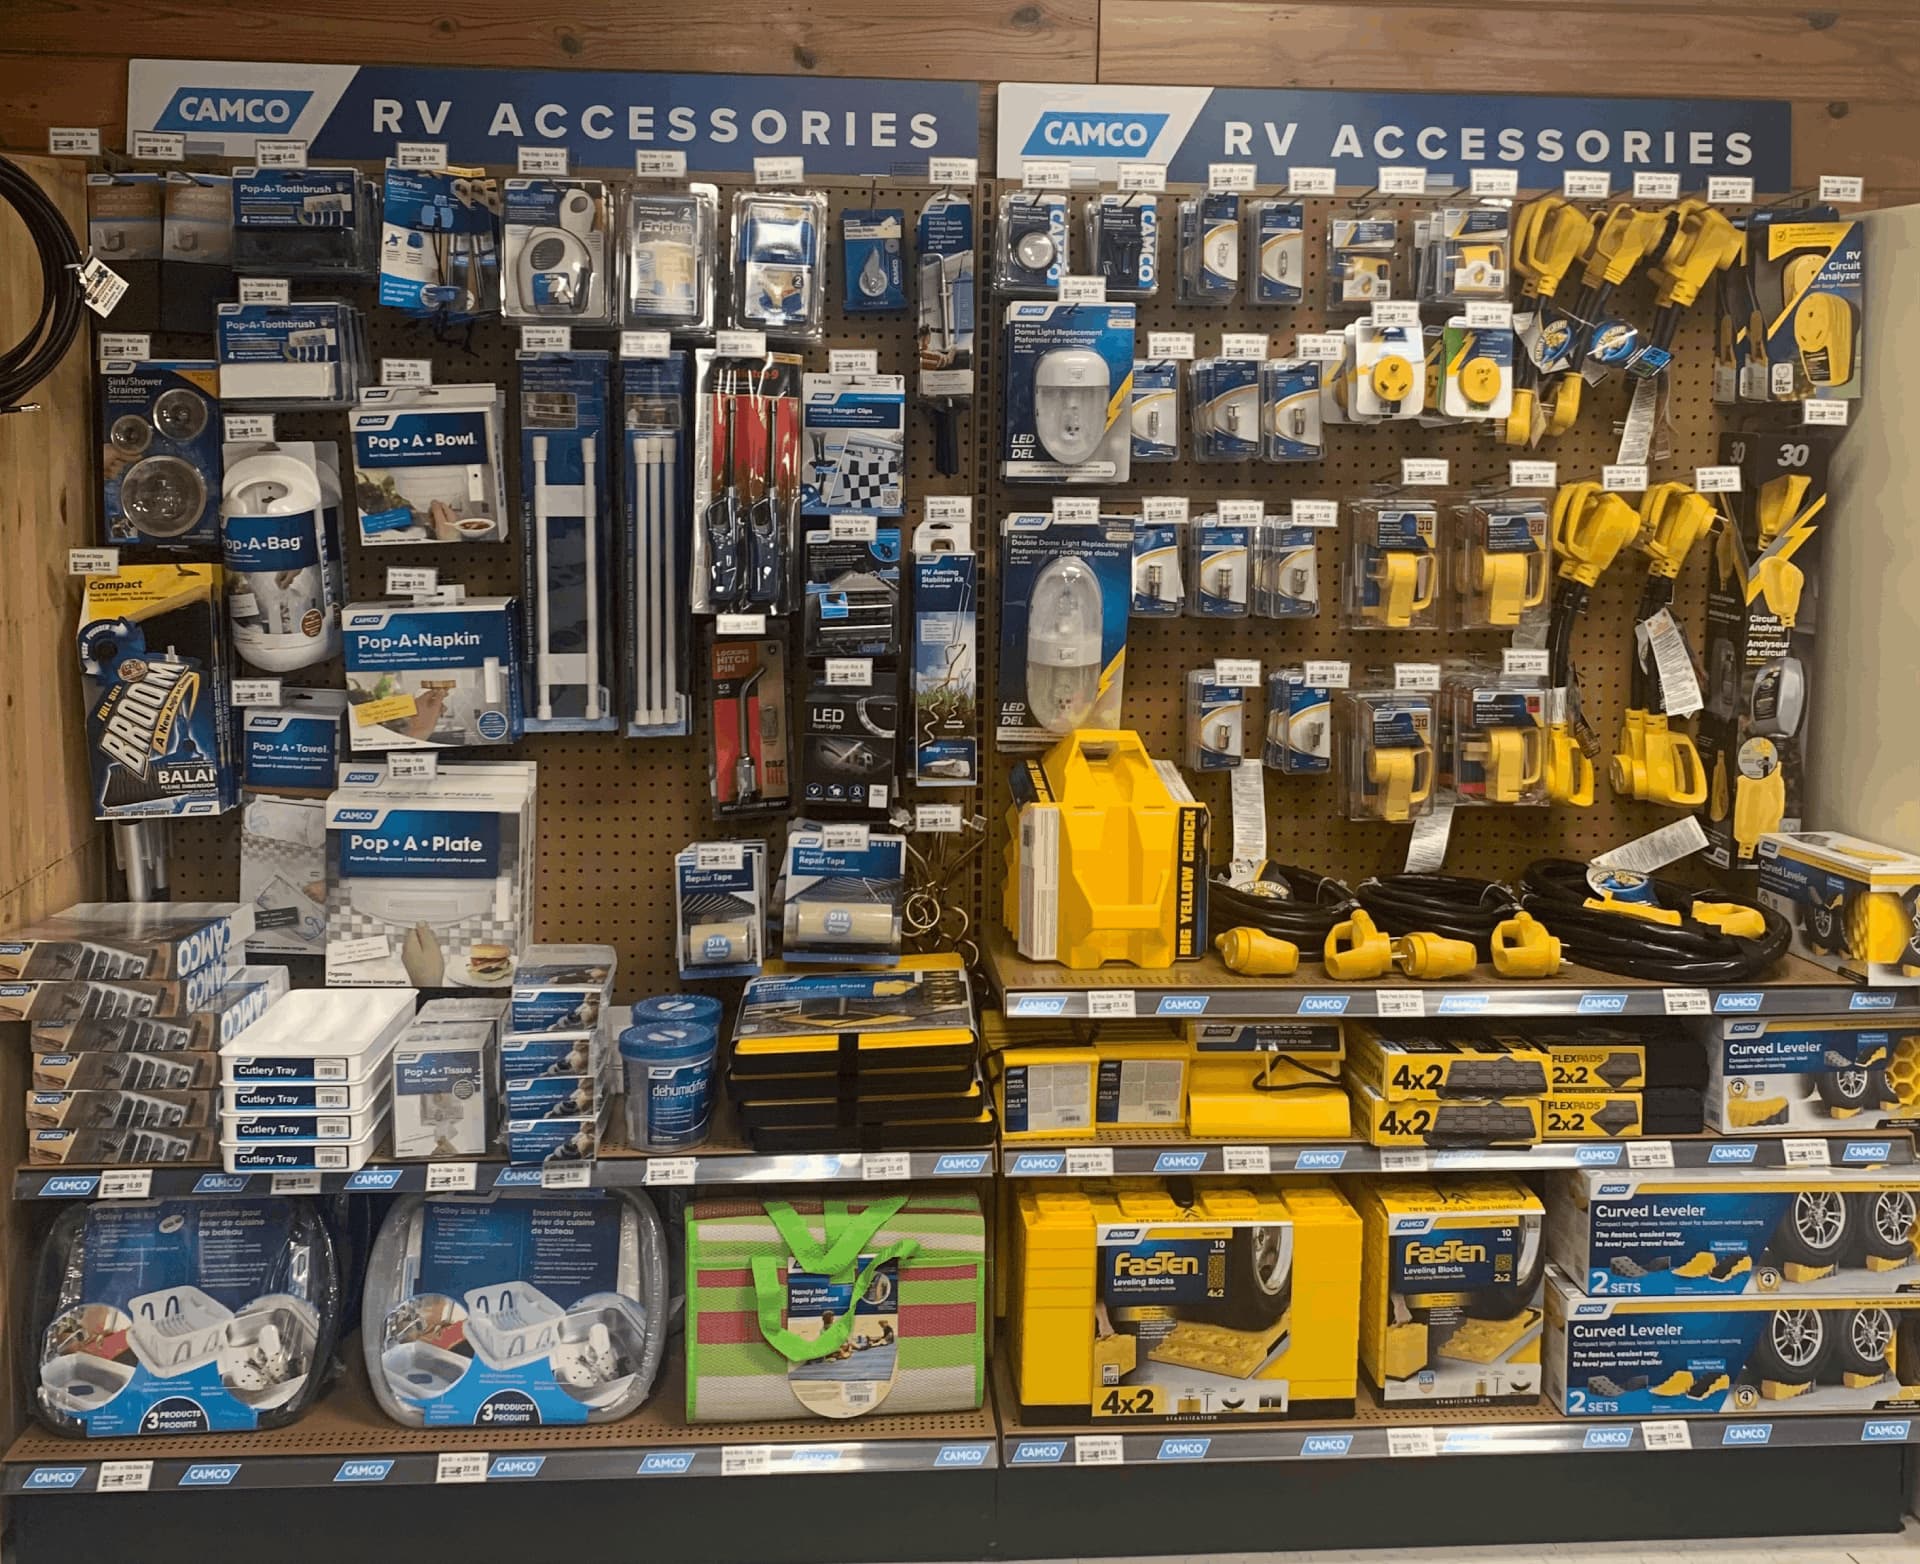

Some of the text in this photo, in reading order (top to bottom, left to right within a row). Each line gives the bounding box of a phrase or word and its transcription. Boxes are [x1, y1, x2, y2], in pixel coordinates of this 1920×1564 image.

[179, 97, 290, 122] CAMCO
[373, 99, 938, 148] RV ACCESSORIES
[1044, 121, 1148, 147] CAMCO
[1224, 121, 1752, 166] RV ACCESSORIES
[1140, 210, 1155, 280] CAMCO
[1846, 251, 1861, 260] RV
[1829, 261, 1861, 271] Circuit
[1817, 272, 1861, 282] Analyzer
[1039, 329, 1055, 337] Light
[1057, 329, 1103, 337] Replacement
[1063, 337, 1096, 345] rechange
[107, 377, 162, 387] Sink/Shower
[108, 385, 146, 396] Strainers
[809, 407, 872, 415] Awning Hanger Clips
[1013, 434, 1034, 444] LED
[1012, 448, 1034, 458] DEL
[1777, 443, 1809, 467] 30
[1039, 539, 1060, 547] Dome
[1061, 540, 1079, 548] Light
[1080, 541, 1128, 549] Replacement
[1060, 549, 1093, 557] rechange
[89, 580, 142, 590] Compact
[1750, 614, 1778, 623] Circuit
[1748, 624, 1786, 633] Analyzer
[1747, 640, 1790, 650] Analyseur
[717, 655, 749, 664] HITCH
[717, 664, 736, 673] PIN
[1002, 702, 1025, 712] LED
[812, 707, 845, 723] LED
[100, 662, 190, 781] BROOM
[1002, 716, 1024, 726] DEL
[340, 812, 373, 821] CAMCO
[799, 856, 845, 866] Repair Tape
[1760, 860, 1808, 885] Curved Leveler
[685, 873, 732, 883] Repair Tape
[1179, 809, 1197, 956] BIG YELLOW CHOCK
[830, 912, 848, 920] DIY
[708, 938, 726, 947] DIY
[1164, 1000, 1201, 1011] CAMCO
[1305, 1000, 1342, 1011] CAMCO
[1729, 1042, 1822, 1055] Curved Leveler
[43, 1057, 67, 1065] CAMCO
[1551, 1053, 1603, 1063] FLEXPADS
[239, 1066, 297, 1077] Cutlery Tray
[1552, 1067, 1588, 1084] 2x2
[1392, 1064, 1444, 1091] 4x2
[1733, 1081, 1742, 1092] 4
[240, 1095, 298, 1105] Cutlery Tray
[1547, 1100, 1600, 1111] FLEXPADS
[1379, 1109, 1431, 1135] 4x2
[1547, 1113, 1584, 1131] 2x2
[241, 1125, 299, 1135] Cutlery Tray
[1714, 1148, 1751, 1159] CAMCO
[1849, 1145, 1885, 1157] CAMCO
[239, 1154, 297, 1165] Cutlery Tray
[943, 1159, 980, 1169] CAMCO
[1021, 1158, 1058, 1170] CAMCO
[1162, 1156, 1199, 1167] CAMCO
[1302, 1154, 1340, 1165] CAMCO
[354, 1174, 394, 1184] CAMCO
[50, 1180, 90, 1191] CAMCO
[533, 1209, 592, 1218] Ensemble pour
[1596, 1204, 1706, 1218] Curved Leveler
[531, 1227, 574, 1235] de bateau
[1501, 1229, 1512, 1237] 10
[1214, 1240, 1226, 1249] 10
[1404, 1266, 1463, 1275] Leveling Blocks
[1113, 1277, 1174, 1287] Leveling Blocks
[1591, 1271, 1641, 1294] 2 SETS
[1765, 1273, 1772, 1284] 4
[791, 1288, 813, 1297] Handy
[1573, 1324, 1683, 1338] Curved Leveler
[1601, 1360, 1616, 1368] your
[1100, 1390, 1154, 1414] 4x2
[1569, 1391, 1618, 1413] 2 SETS
[1742, 1392, 1750, 1402] 4
[482, 1403, 534, 1421] 3 PRODUCTS
[494, 1413, 530, 1421] PRODUITS
[148, 1410, 201, 1429] 3 PRODUCTS
[159, 1420, 197, 1428] PRODUITS
[1729, 1428, 1767, 1439] CAMCO
[1165, 1444, 1203, 1454] CAMCO
[1308, 1440, 1346, 1450] CAMCO
[943, 1450, 982, 1461] CAMCO
[1021, 1447, 1059, 1457] CAMCO
[496, 1461, 536, 1472] CAMCO
[647, 1457, 687, 1468] CAMCO
[190, 1468, 232, 1479] CAMCO
[345, 1464, 385, 1475] CAMCO
[34, 1472, 75, 1483] CAMCO
